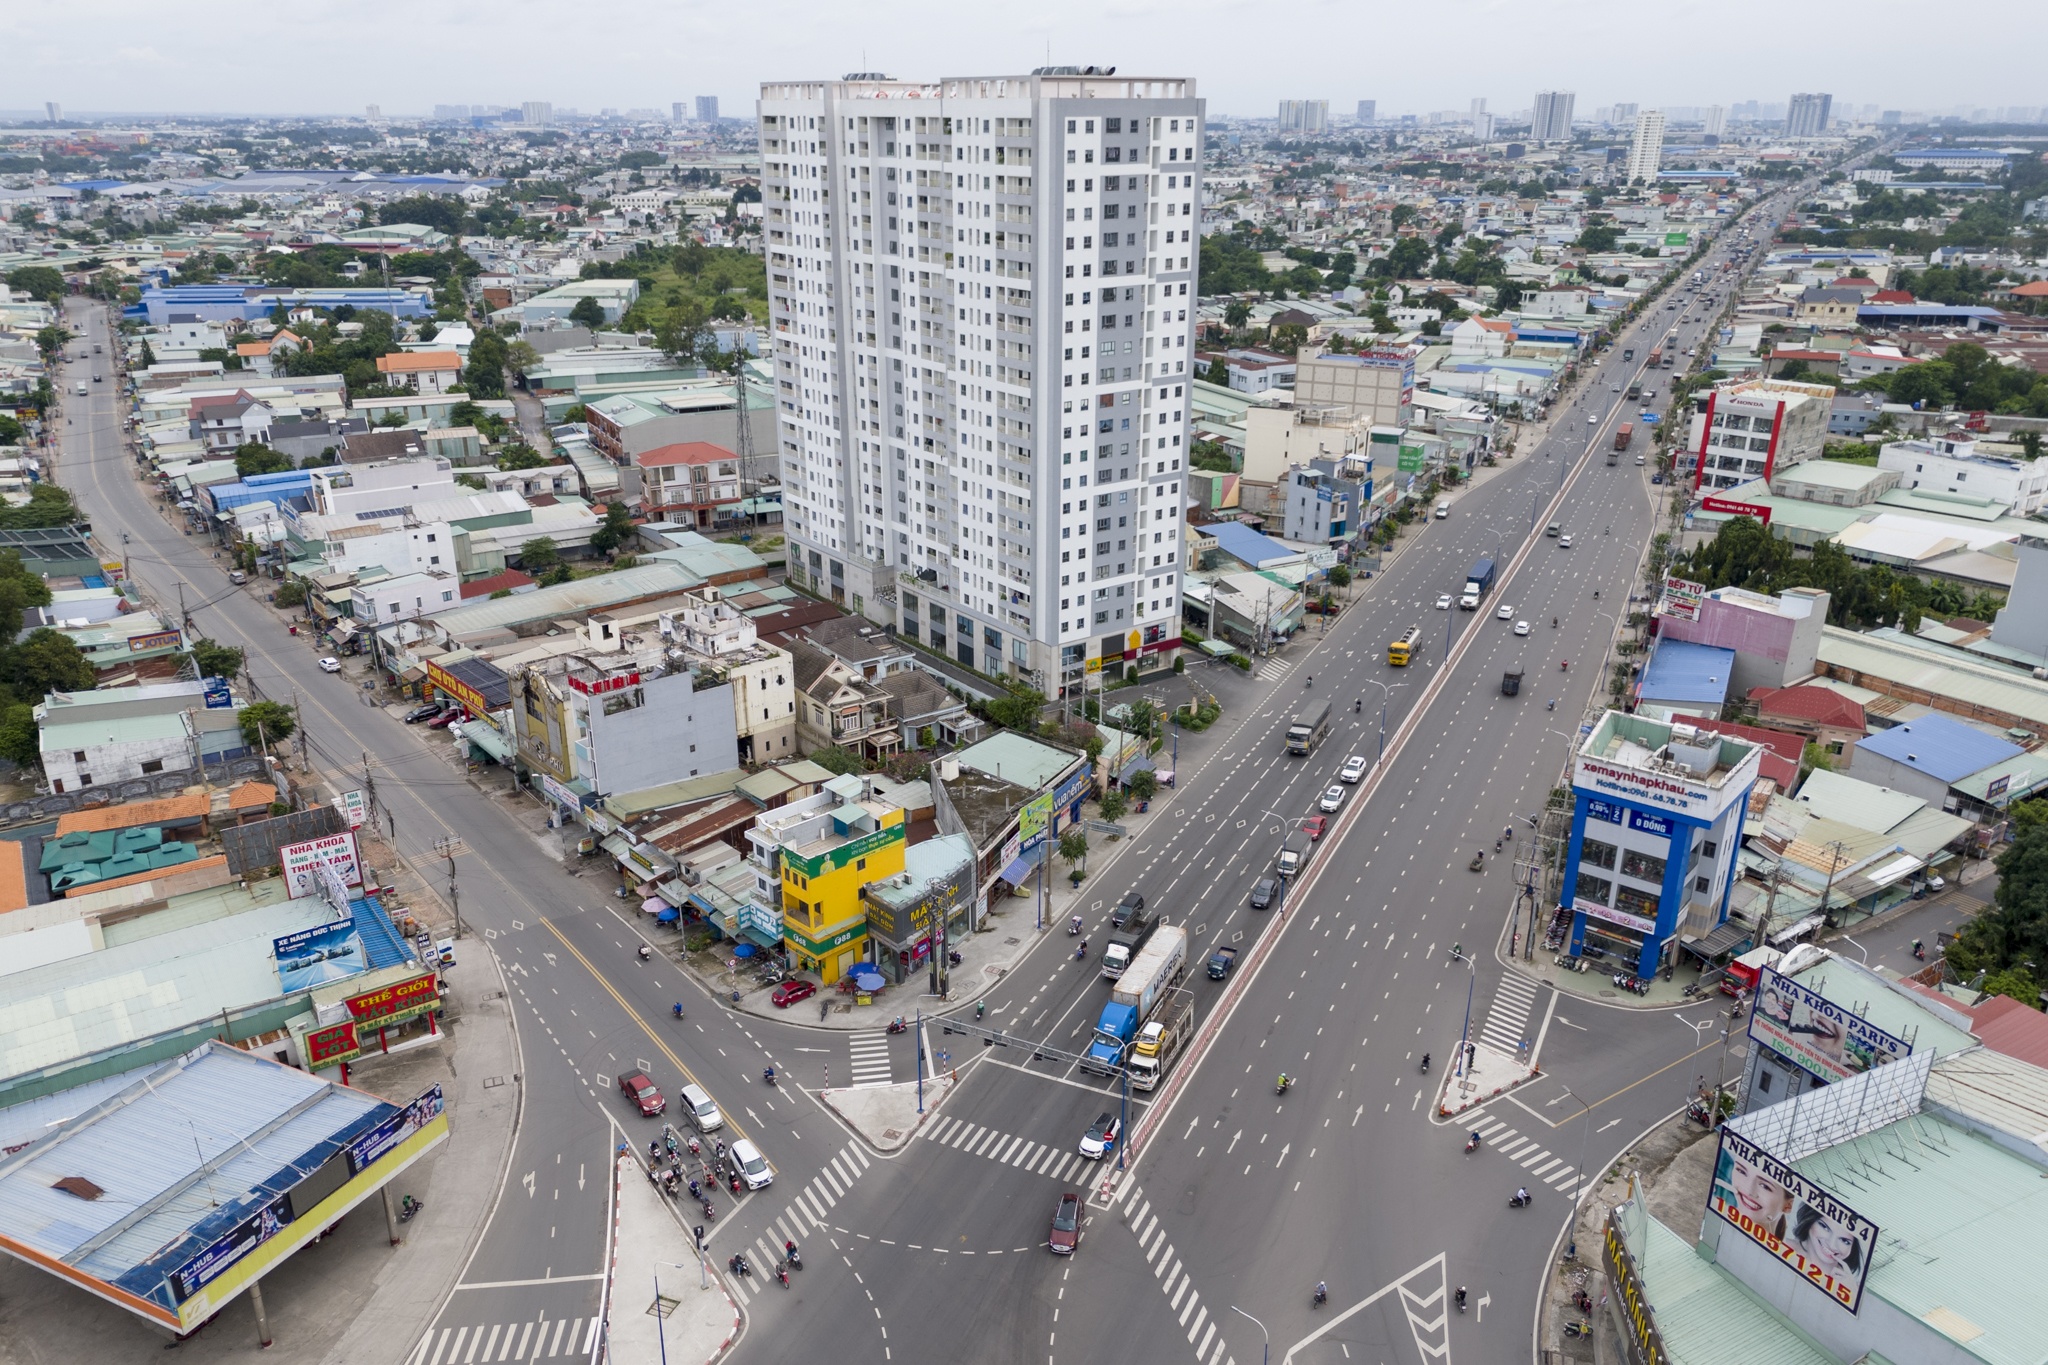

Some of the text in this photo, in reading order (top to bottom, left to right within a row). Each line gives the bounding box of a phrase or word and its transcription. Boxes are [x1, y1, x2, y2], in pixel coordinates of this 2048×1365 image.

[1668, 579, 1703, 594] BẾP TỪ
[144, 635, 178, 647] JOTUN
[208, 695, 228, 703] Dulux
[1583, 762, 1708, 801] xemaynhapkhau.com
[347, 792, 362, 808] NHA KHOA
[1614, 810, 1620, 818] 2
[1636, 818, 1642, 826] 0
[290, 836, 345, 856] NHA KHOA
[328, 854, 352, 864] TÂM
[290, 932, 311, 943] NÂNG
[329, 921, 351, 932] THỊNH
[793, 933, 806, 947] F88
[834, 932, 851, 945] F88
[1154, 947, 1182, 994] MAERSK
[356, 980, 430, 1008] THẾ GIỚI
[354, 992, 436, 1024] MẮT KÍNH
[1771, 975, 1799, 1000] NHA
[1803, 996, 1844, 1024] KHOA
[1848, 1018, 1898, 1054] PARI'S
[1771, 1037, 1793, 1056] ISO
[352, 1133, 380, 1156] N-HUB
[1729, 1136, 1869, 1241] NHA KHOA PARI'S 4
[1716, 1196, 1852, 1304] 1900571215
[180, 1252, 214, 1280] N-HUB
